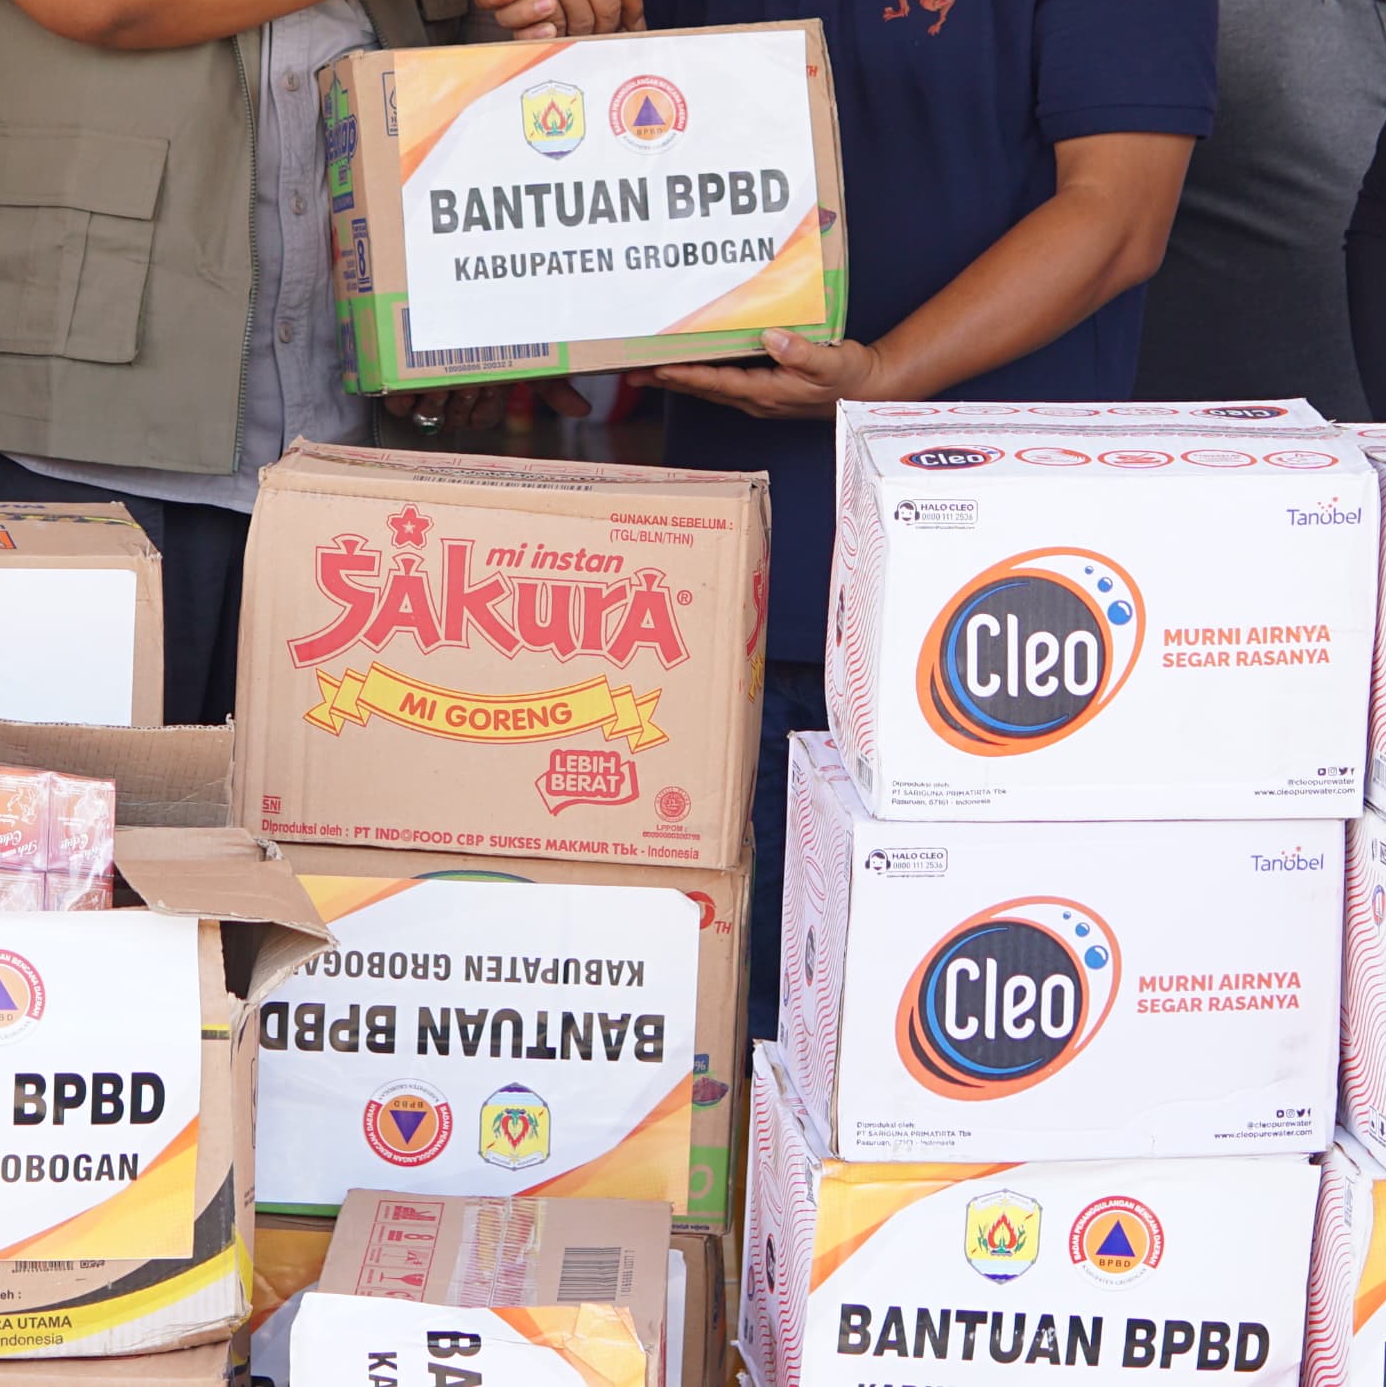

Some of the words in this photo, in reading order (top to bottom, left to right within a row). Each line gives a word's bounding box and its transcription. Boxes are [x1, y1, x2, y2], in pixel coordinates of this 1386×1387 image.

[430, 176, 649, 235] BANTUAN
[666, 169, 790, 220] BPBD
[454, 247, 614, 282] KABUPATEN
[625, 237, 776, 271] GROBOGAN
[917, 450, 987, 467] Cleo
[610, 513, 668, 526] GUNAKAN
[671, 516, 726, 530] SEBELUM
[610, 529, 694, 547] (TGL/BLN/THN)
[487, 542, 528, 568] mi
[533, 546, 624, 574] instan
[1163, 626, 1241, 646] MURNI
[1246, 624, 1331, 645] AIRNYA
[965, 613, 1099, 699] Cleo
[1163, 649, 1231, 668] SEGAR
[1236, 648, 1330, 666] RASANYA
[399, 692, 437, 722] MI
[445, 701, 573, 732] GORENG
[554, 754, 617, 774] LEBIH
[550, 772, 621, 794] BERAT
[262, 798, 281, 811] SNI
[261, 819, 317, 837] Diproduksi
[320, 823, 343, 836] oleh
[354, 826, 372, 839] PT
[457, 830, 484, 846] CBP
[489, 833, 542, 850] SUKSES
[545, 838, 609, 855] MAKMUR
[612, 843, 638, 857] Tbk
[648, 845, 700, 860] Indonesia
[892, 852, 918, 860] HALO
[919, 852, 944, 860] CLEO
[714, 920, 732, 935] TH
[294, 950, 451, 982] GROBOGA
[464, 954, 646, 987] KABUPATEN
[1137, 973, 1214, 993] MURNI
[1218, 972, 1302, 991] AIRNYA
[944, 957, 1076, 1041] Cleo
[1136, 996, 1205, 1014] SEGAR
[1209, 994, 1300, 1012] RASANYA
[260, 1001, 397, 1054] BPBD
[417, 1007, 665, 1064] BANTUAN
[13, 1072, 167, 1127] BPBD
[1099, 1258, 1131, 1268] BPBD
[17, 1315, 73, 1330] UTAMA
[836, 1303, 1104, 1367] BANTUAN
[1122, 1317, 1271, 1373] BPBD
